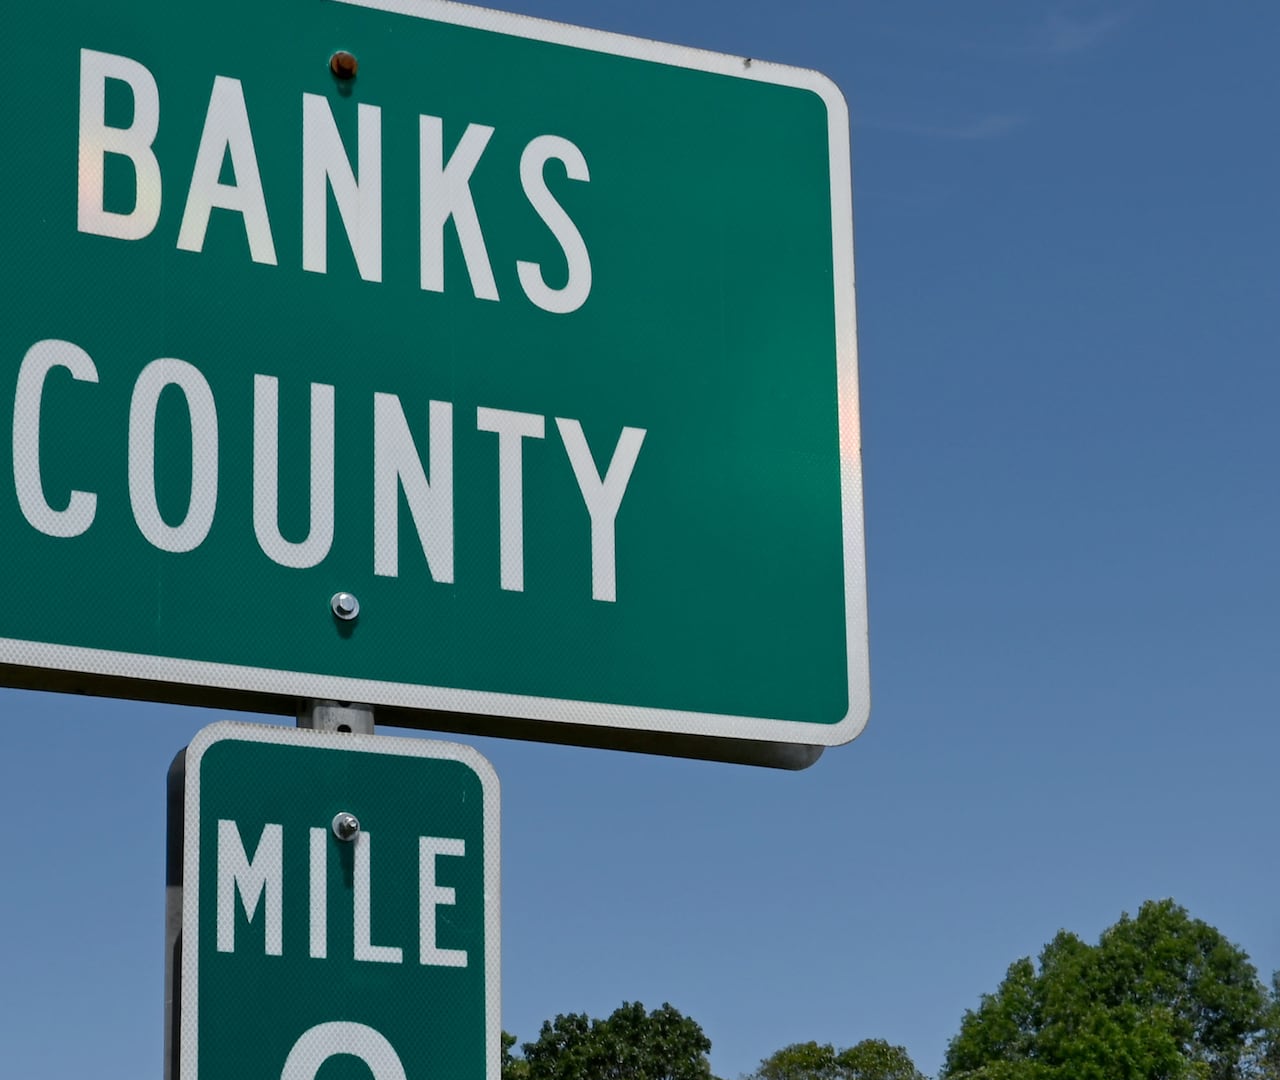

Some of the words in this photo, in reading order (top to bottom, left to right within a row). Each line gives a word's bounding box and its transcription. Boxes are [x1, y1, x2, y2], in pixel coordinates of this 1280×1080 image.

[76, 47, 593, 315] BANKS
[11, 338, 648, 602] COUNTY
[216, 819, 468, 968] MILE
